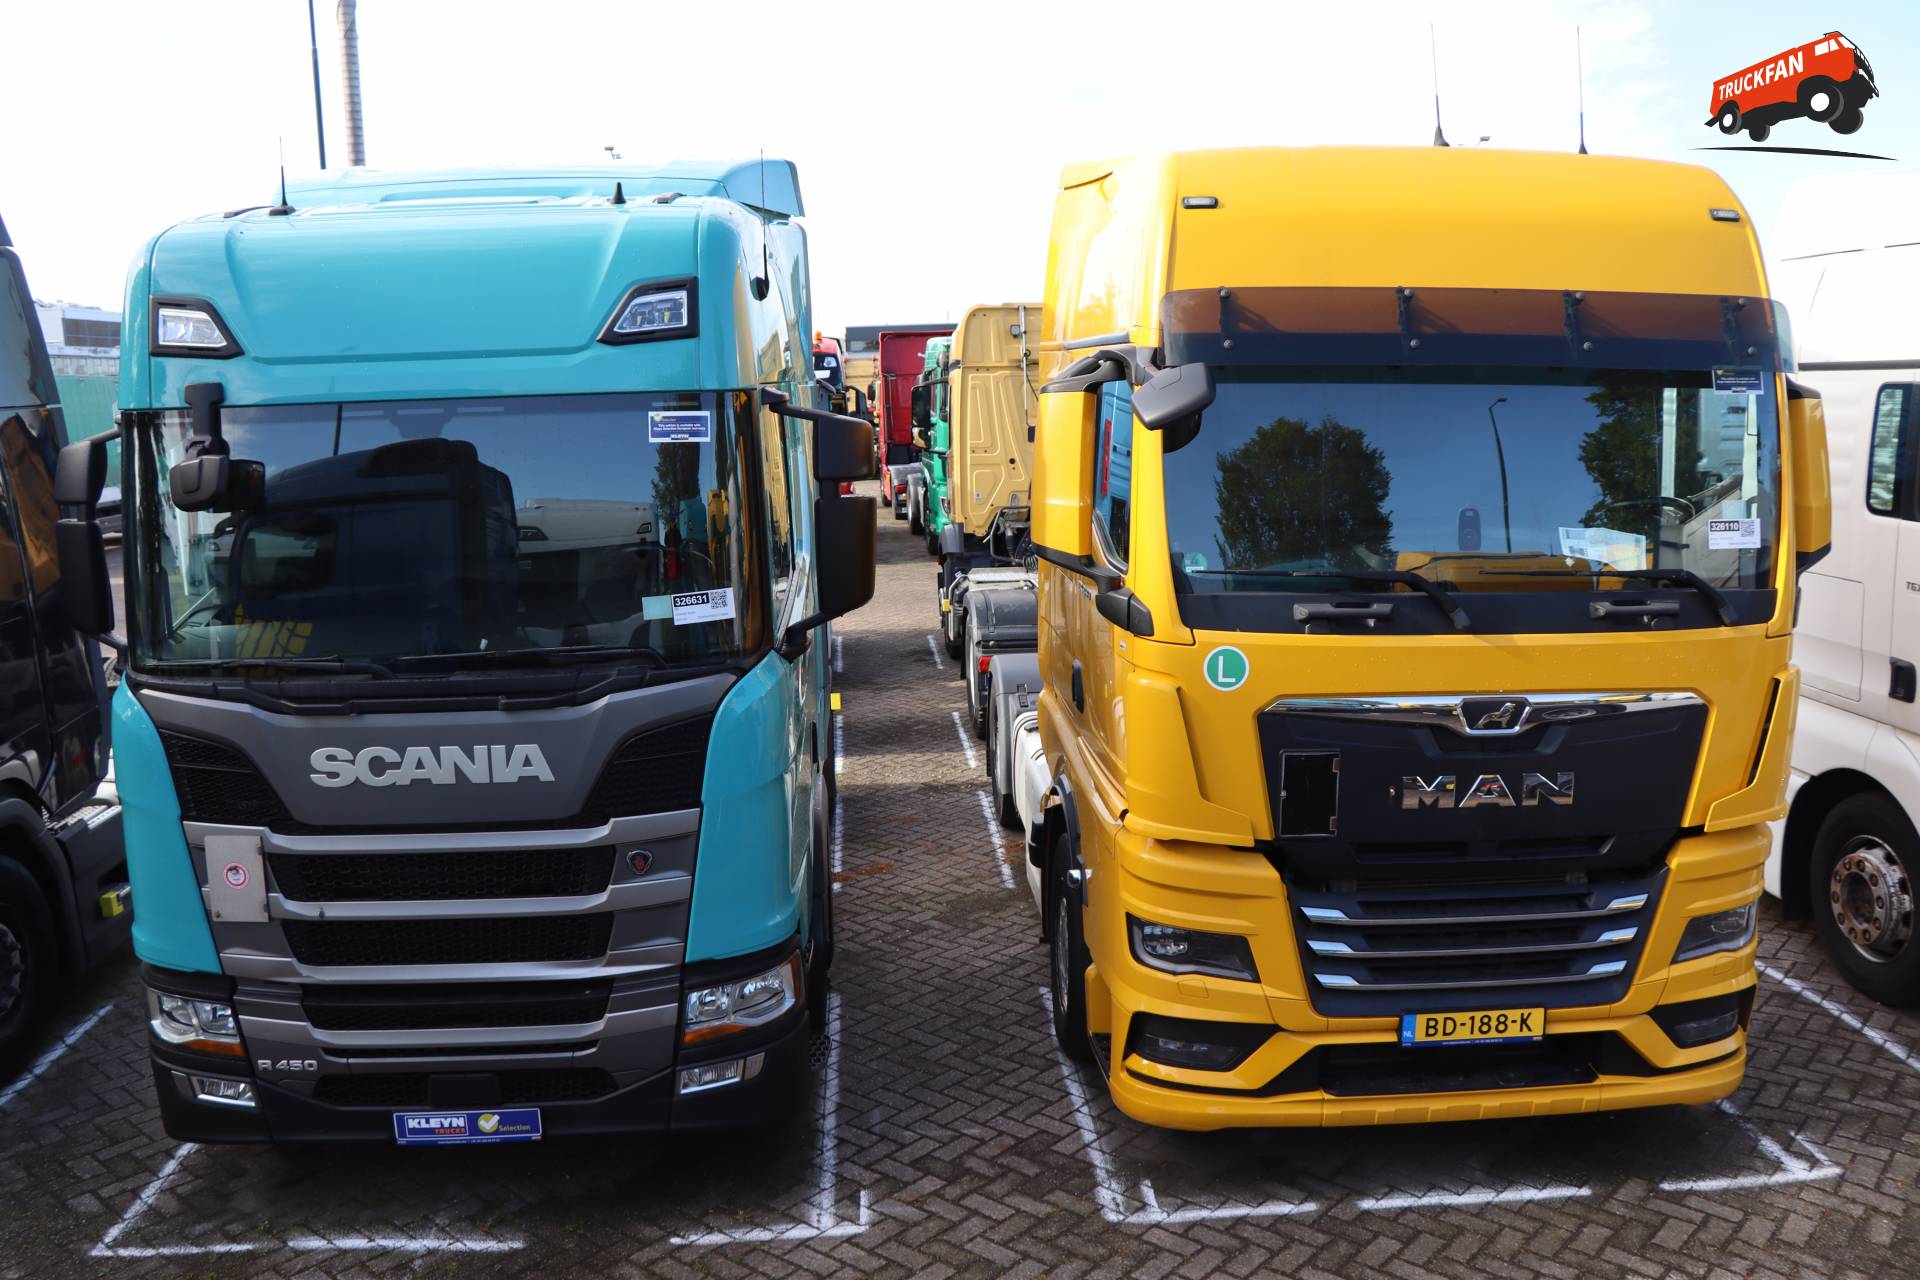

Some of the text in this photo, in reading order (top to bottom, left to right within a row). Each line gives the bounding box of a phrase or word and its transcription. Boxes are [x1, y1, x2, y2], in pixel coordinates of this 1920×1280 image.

[1711, 522, 1739, 531] 326110
[674, 594, 708, 606] 326631
[1217, 655, 1236, 683] L
[309, 743, 556, 788] SCANIA
[1401, 771, 1575, 809] MAN
[1425, 1011, 1534, 1038] BD-188-K
[1403, 1030, 1414, 1038] NL
[257, 1059, 319, 1072] R 450
[407, 1117, 465, 1129] KLEYN
[498, 1124, 532, 1132] Selection
